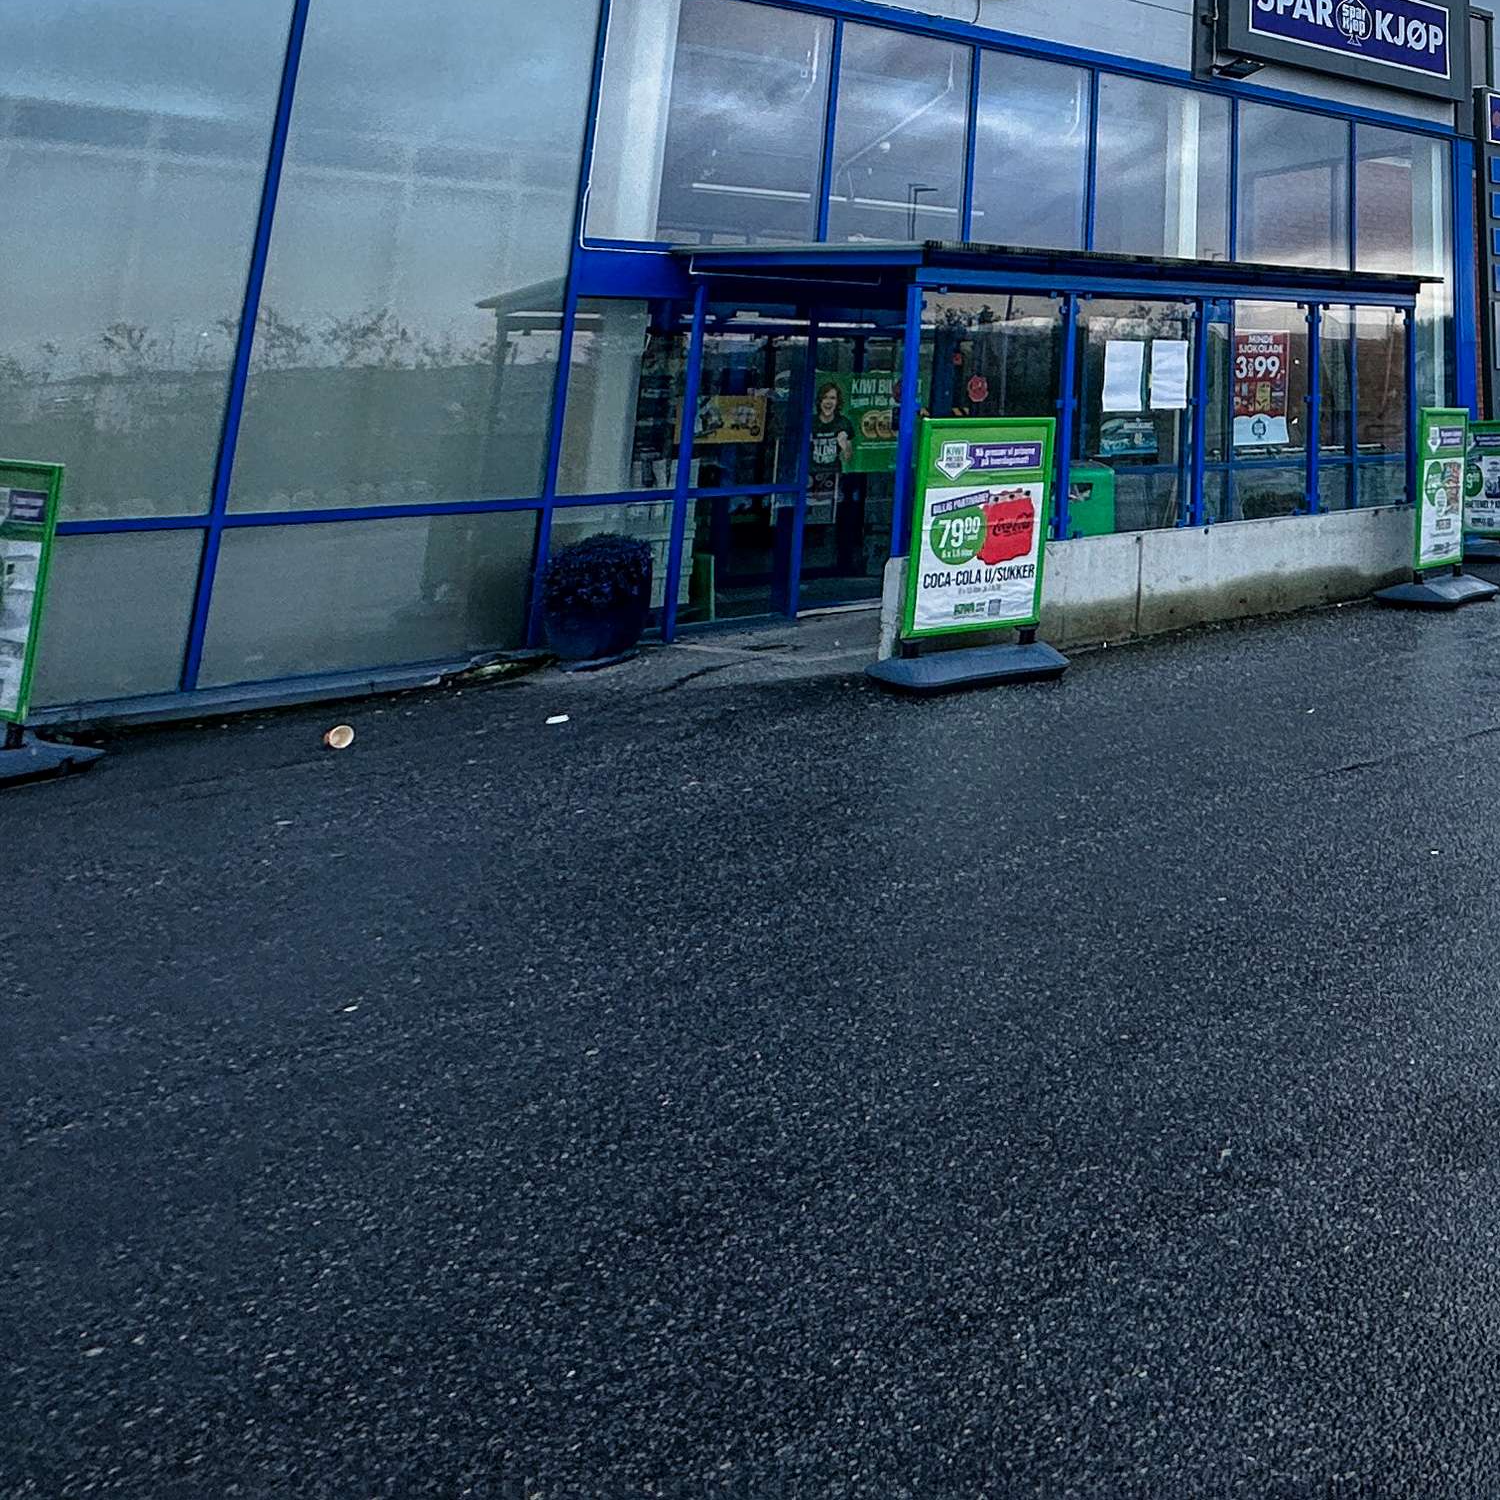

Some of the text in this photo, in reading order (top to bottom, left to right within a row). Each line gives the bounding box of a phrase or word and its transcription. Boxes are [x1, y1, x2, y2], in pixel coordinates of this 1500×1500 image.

[1375, 9, 1444, 54] KJØP
[1235, 355, 1248, 379] 3
[923, 563, 1036, 589] COCA-COLA U/SUKKER
